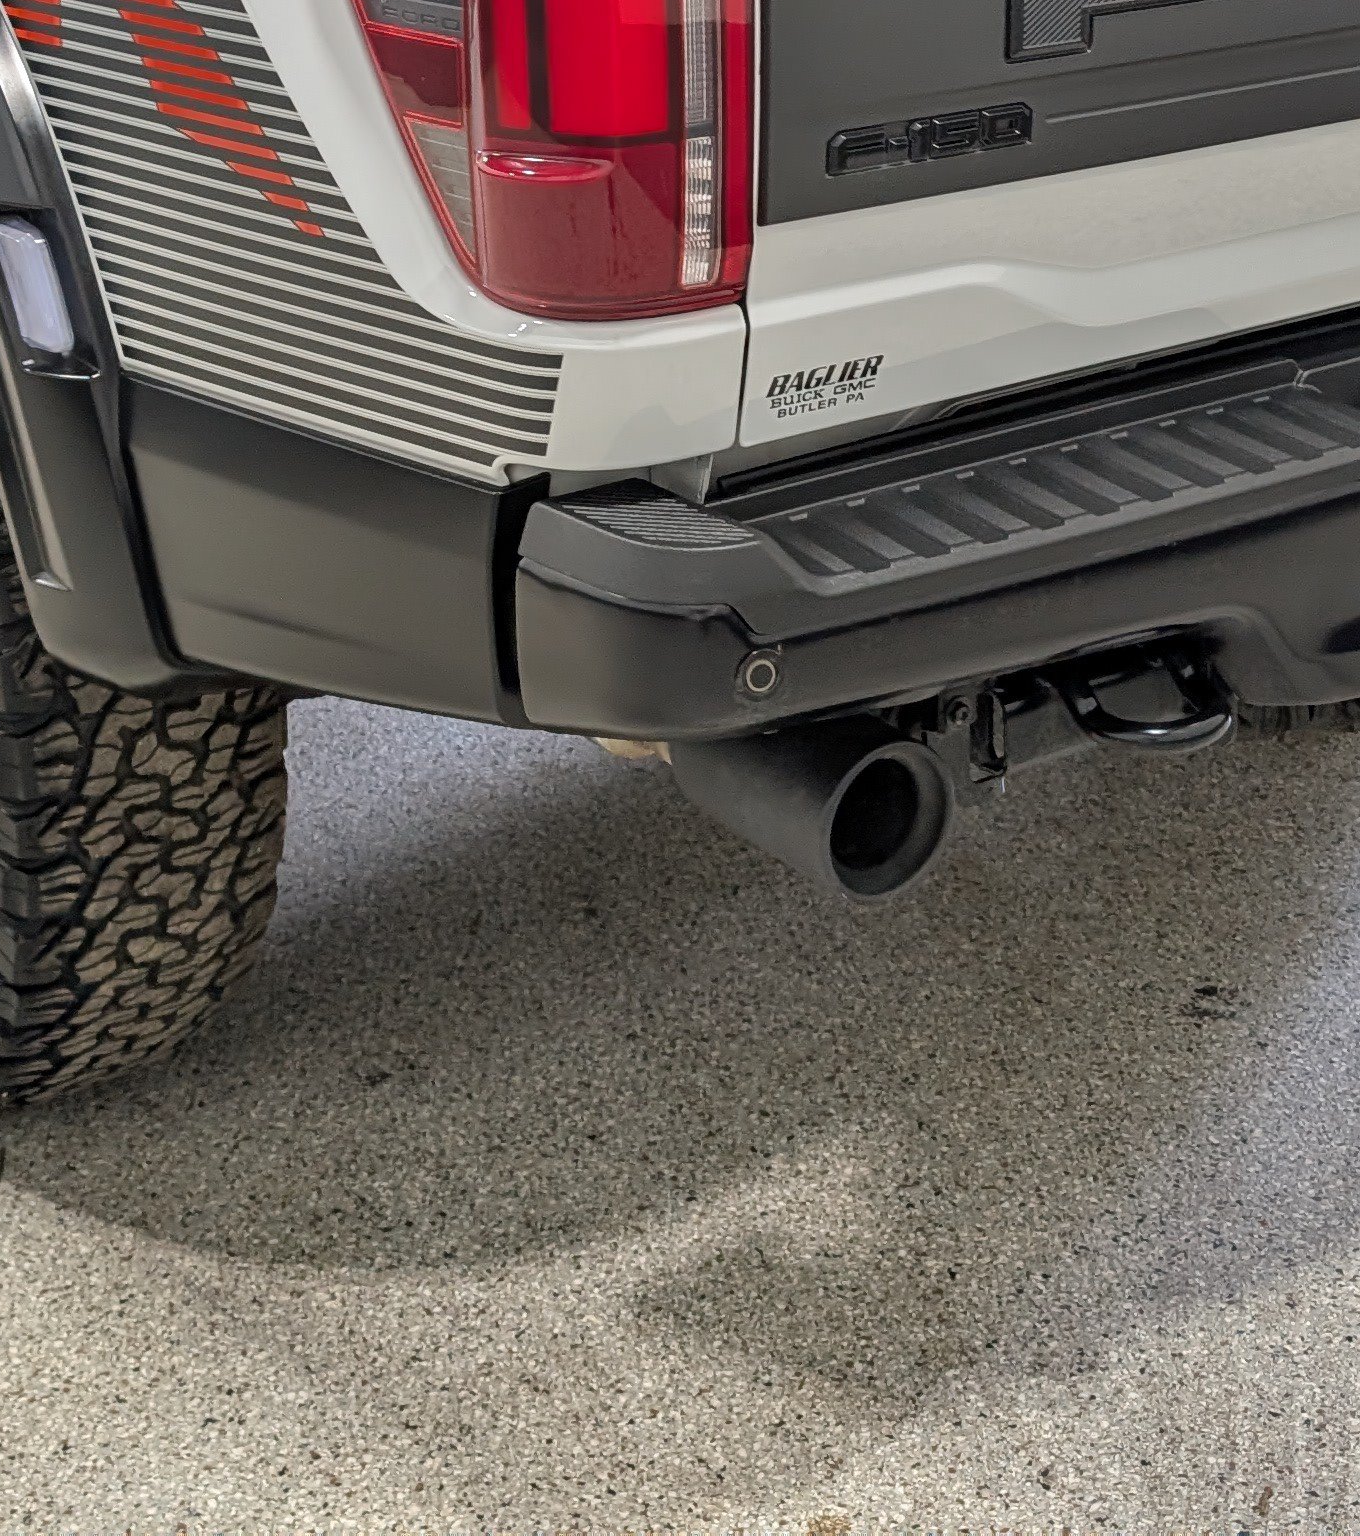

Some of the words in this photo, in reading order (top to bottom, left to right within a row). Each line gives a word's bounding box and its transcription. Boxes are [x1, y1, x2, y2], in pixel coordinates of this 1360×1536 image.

[382, 5, 462, 33] FORD
[825, 101, 1034, 178] F-150
[766, 354, 885, 399] BAGLIER
[769, 388, 825, 410] BUICK
[833, 377, 876, 395] GMC
[777, 398, 838, 419] BUTLER
[845, 392, 865, 404] PA
